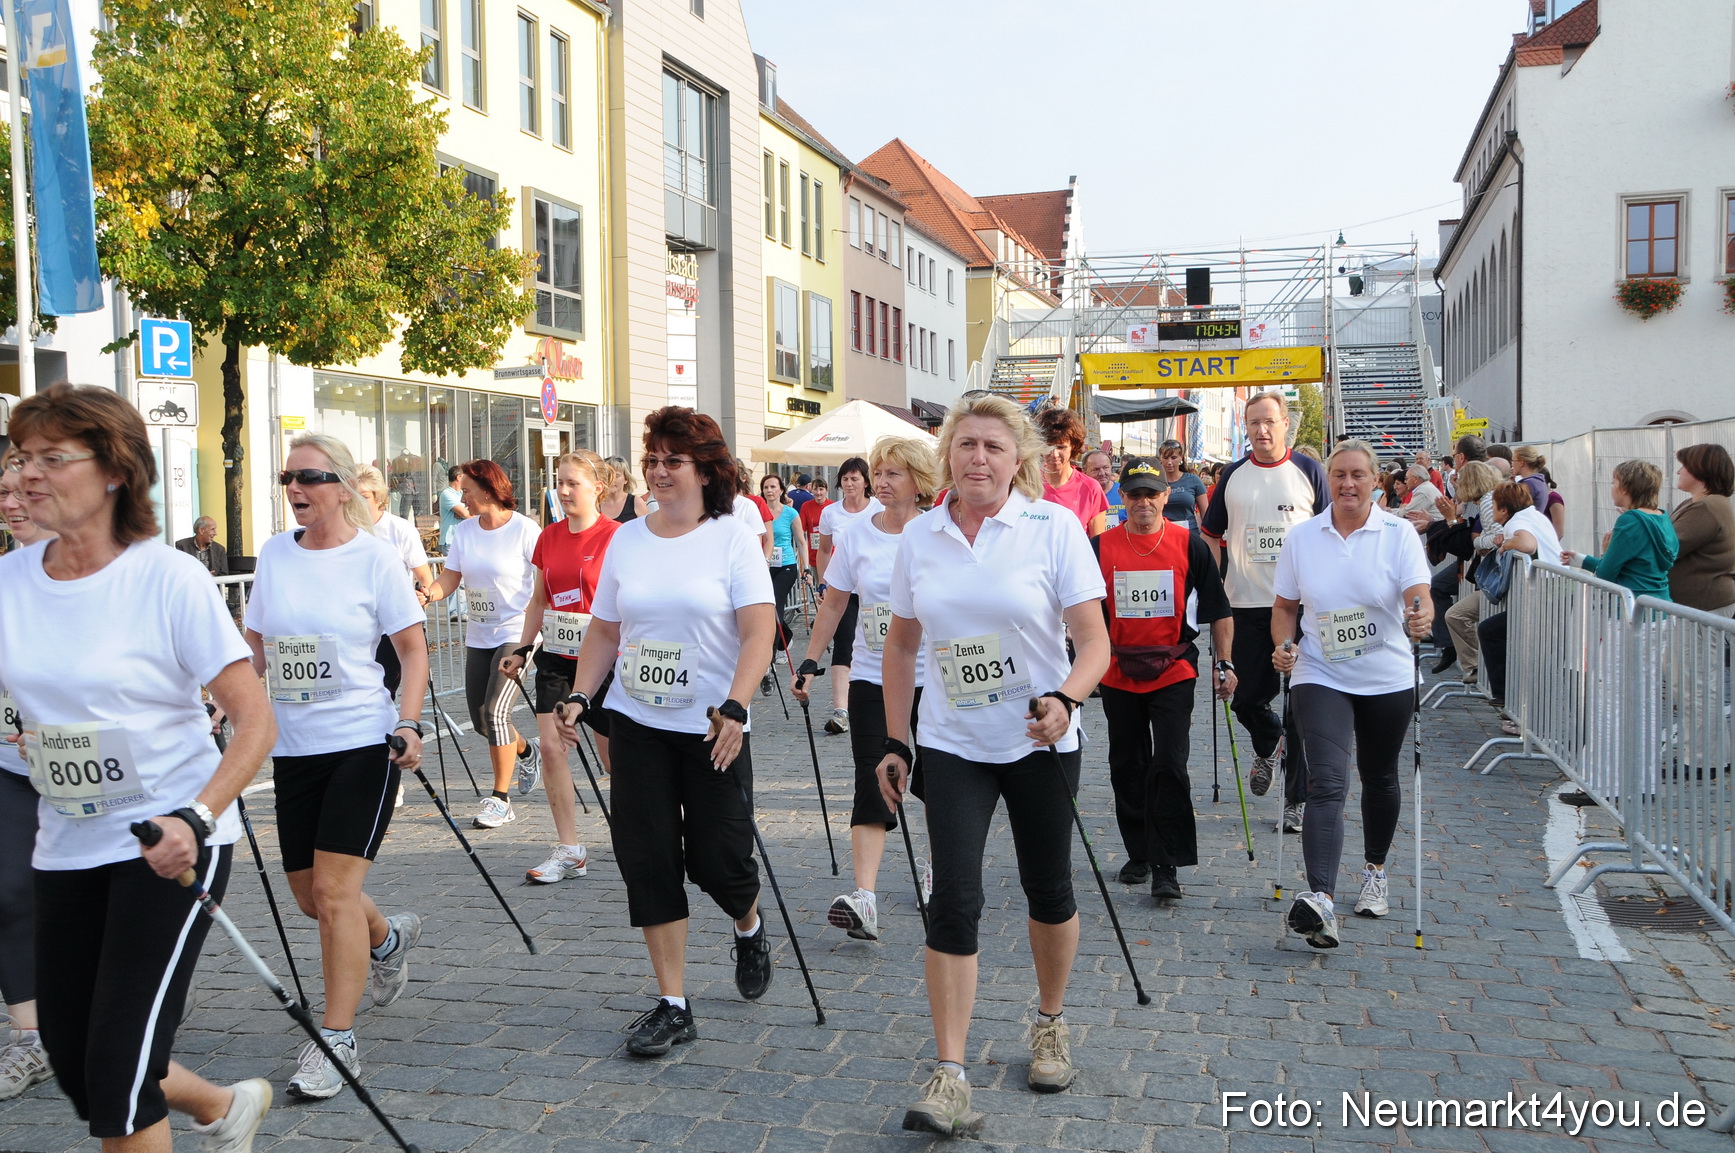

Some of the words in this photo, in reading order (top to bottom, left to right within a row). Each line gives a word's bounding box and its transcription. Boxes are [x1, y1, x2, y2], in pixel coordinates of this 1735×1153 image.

[666, 245, 699, 280] ltstadt
[666, 280, 699, 308] assage
[1196, 324, 1239, 337] 17:04:34
[152, 326, 180, 369] P
[494, 368, 541, 378] Brunnwirtsgasse
[1157, 356, 1240, 378] START
[1258, 525, 1285, 533] Wolfram
[1260, 537, 1286, 548] 804
[1131, 589, 1167, 602] 8101
[470, 601, 495, 611] 8003
[877, 607, 892, 616] Chr
[557, 615, 579, 625] Nicole
[1333, 611, 1365, 624] Annette
[557, 629, 581, 642] 801
[1337, 622, 1377, 643] 8030
[278, 641, 316, 656] Brigitte
[640, 644, 681, 661] Irmgard
[954, 643, 985, 657] Zenta
[282, 661, 332, 680] 8002
[622, 661, 628, 670] N
[639, 665, 689, 686] 8004
[941, 665, 948, 675] N
[961, 656, 1016, 684] 8031
[998, 683, 1032, 697] PFLEIDERER
[42, 732, 91, 750] Andrea
[49, 758, 124, 786] 8008
[96, 793, 145, 808] PFLEIDERER
